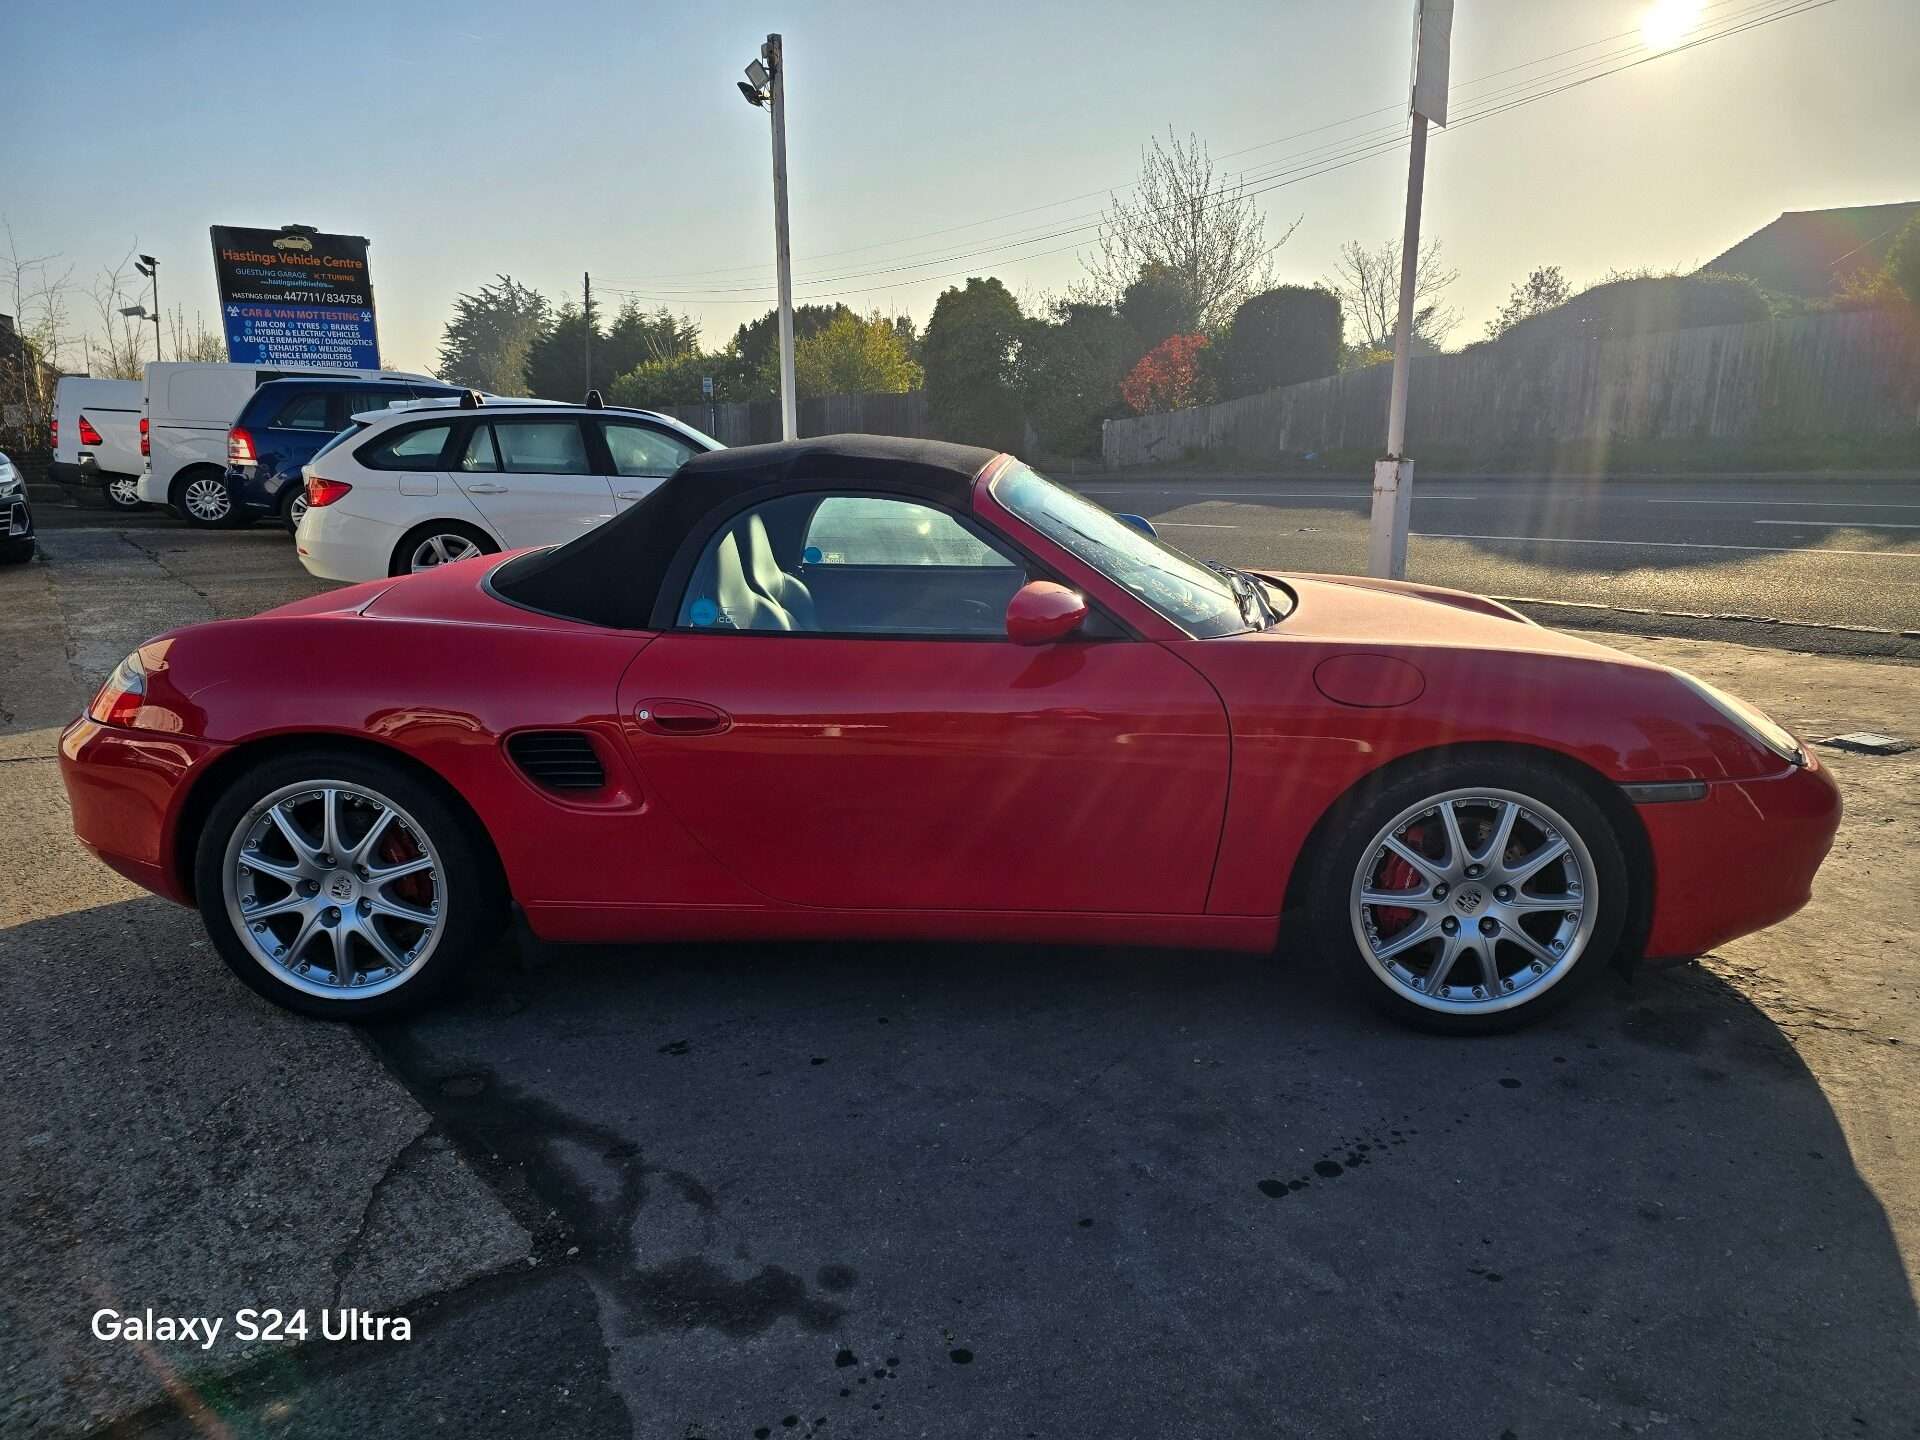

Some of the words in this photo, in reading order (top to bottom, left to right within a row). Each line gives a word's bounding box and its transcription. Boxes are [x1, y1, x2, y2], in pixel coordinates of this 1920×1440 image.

[222, 248, 277, 265] Hastings
[278, 253, 321, 266] Vehicle
[323, 256, 362, 268] Centre
[277, 270, 307, 279] GARAGE
[232, 292, 262, 300] HASTINGS
[284, 291, 364, 304] 447711/834758
[242, 308, 261, 318] CAR
[264, 309, 272, 318] &
[272, 310, 295, 318] VAN
[296, 310, 319, 320] MOT
[320, 312, 360, 321] TESTING
[292, 330, 326, 338] ELECTRIC
[326, 331, 360, 339] VEHICLES
[276, 336, 320, 345] REMAPPING
[325, 338, 374, 346] DIAGNOSTICS
[301, 352, 353, 360] IMMOBILISERS
